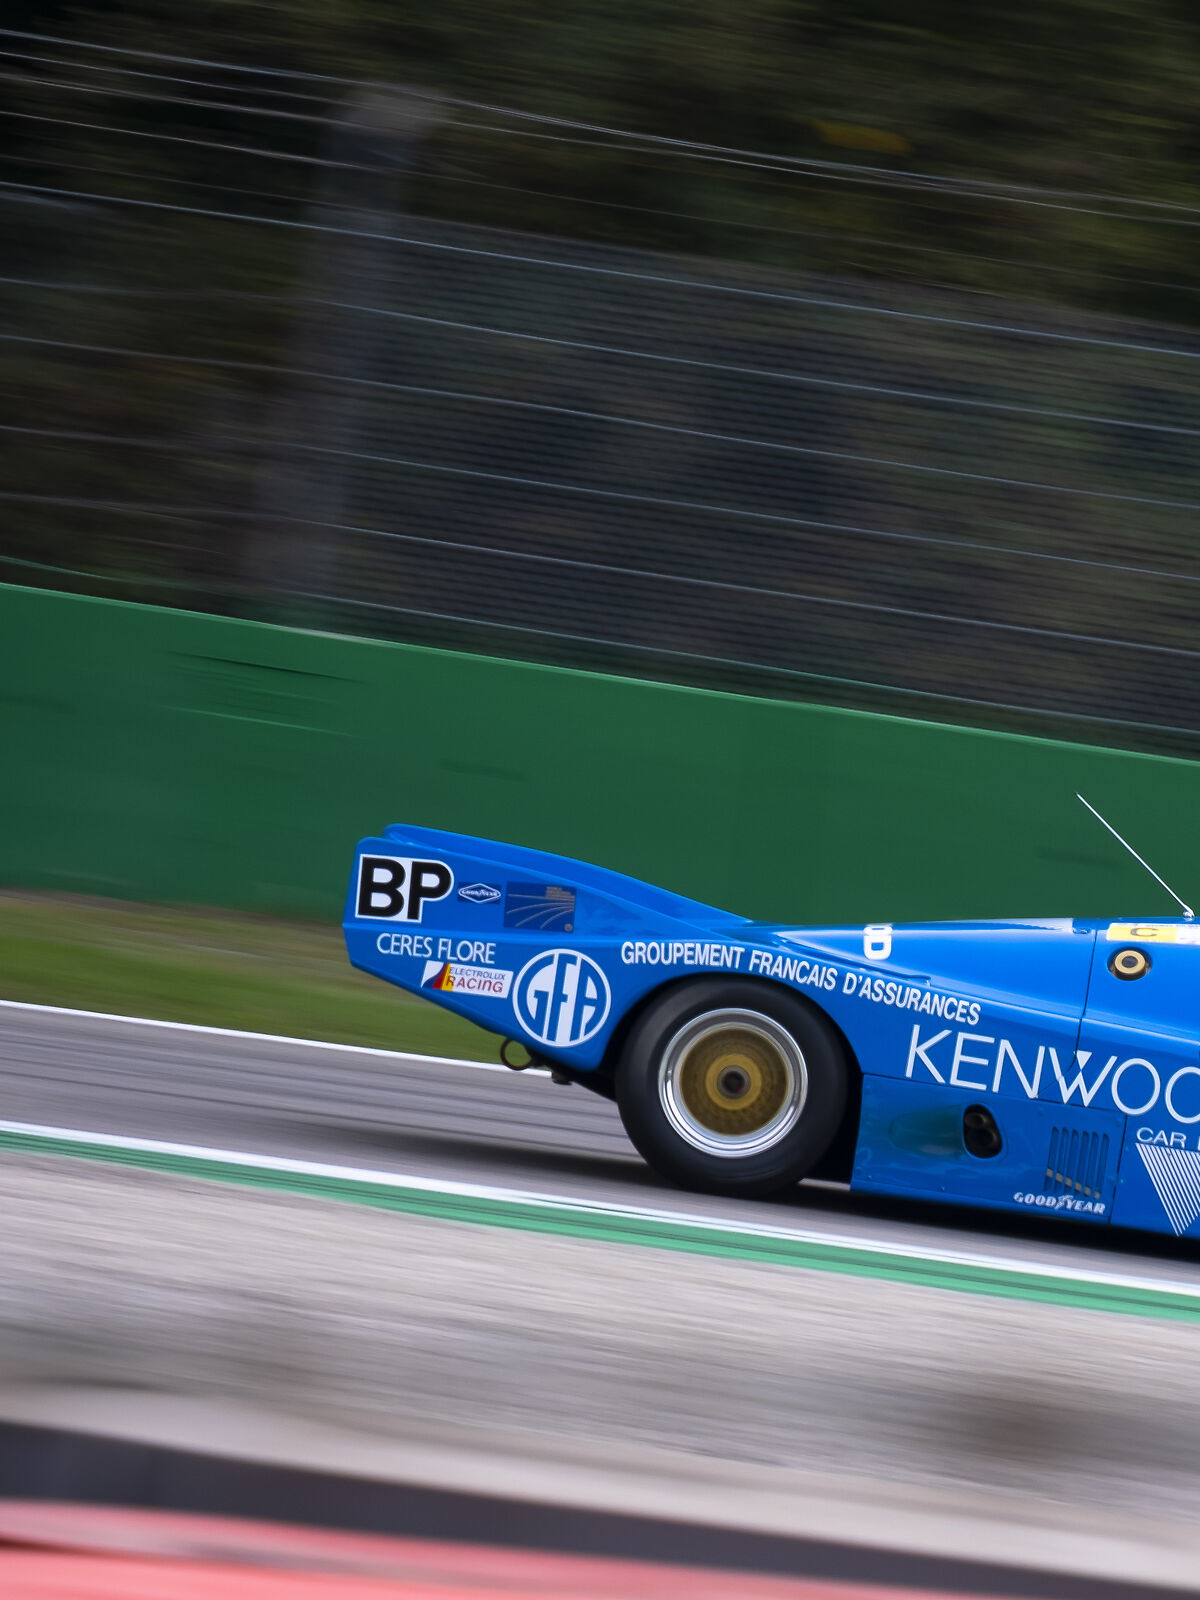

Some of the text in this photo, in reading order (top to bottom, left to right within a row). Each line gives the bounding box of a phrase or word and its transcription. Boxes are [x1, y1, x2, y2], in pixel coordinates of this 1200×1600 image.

[357, 858, 452, 921] BP
[376, 933, 496, 964] CERES FLORE
[449, 967, 506, 980] ELECTROLUX
[621, 941, 981, 1026] GROUPEMENT FRANCAIS D'ASSURANCES
[1136, 1127, 1187, 1148] CAR
